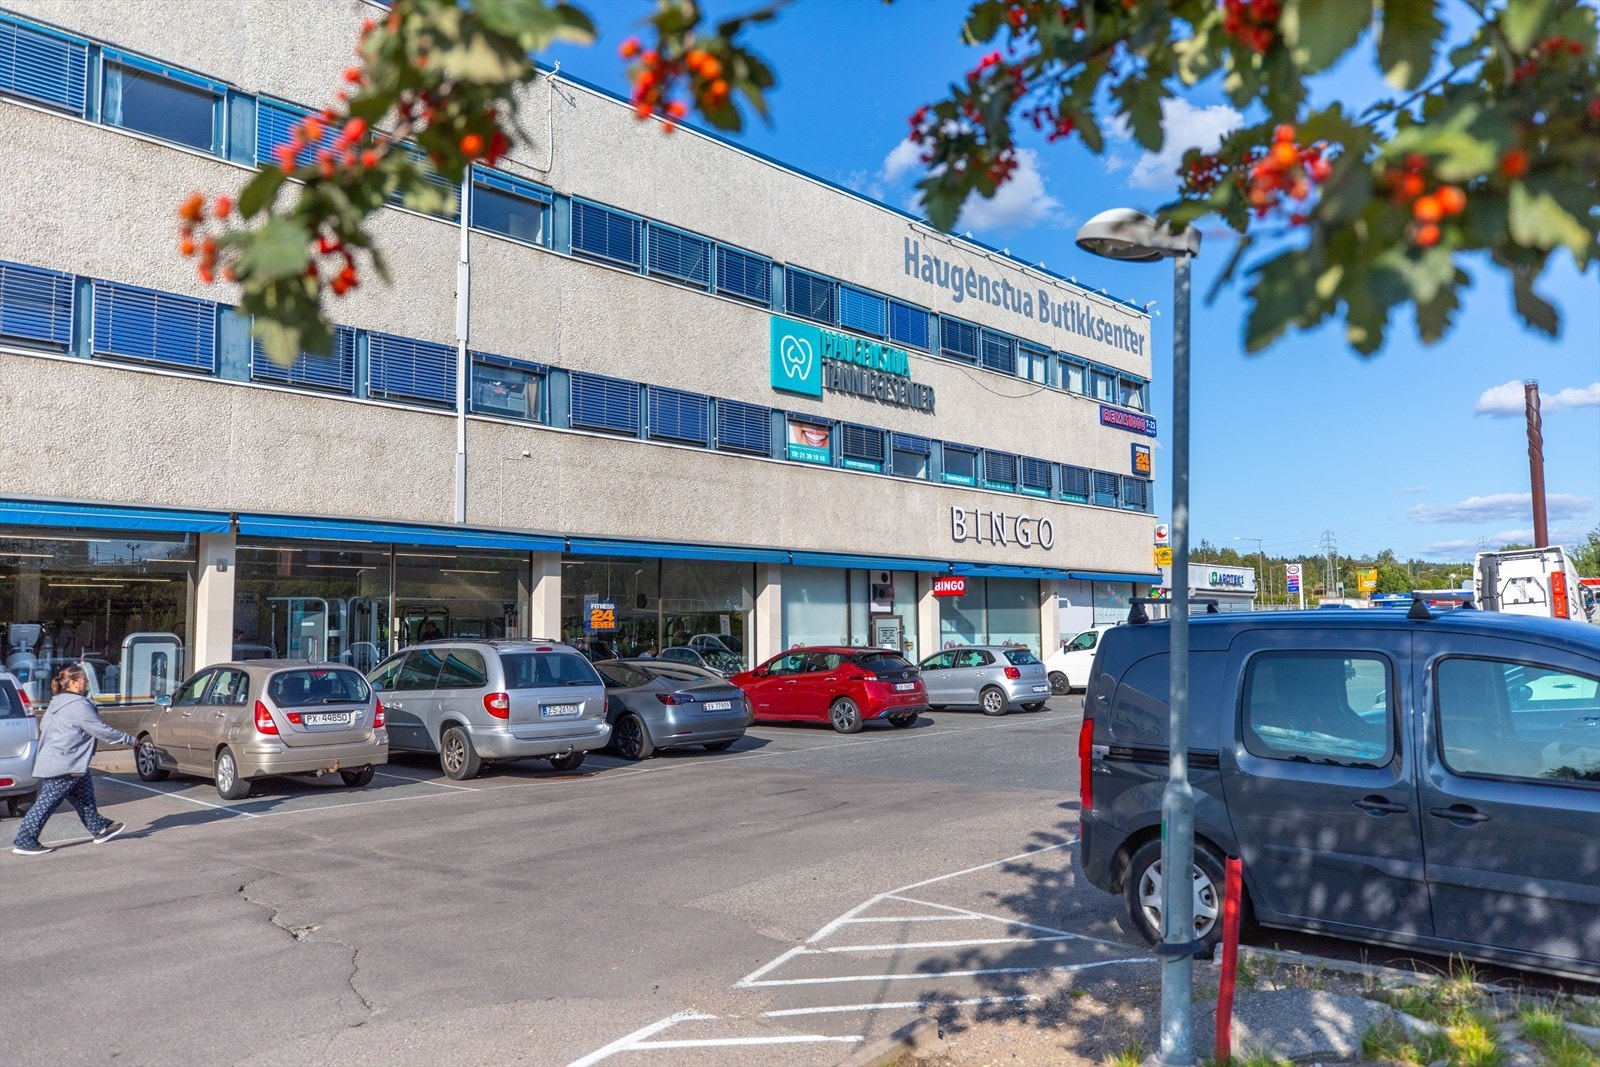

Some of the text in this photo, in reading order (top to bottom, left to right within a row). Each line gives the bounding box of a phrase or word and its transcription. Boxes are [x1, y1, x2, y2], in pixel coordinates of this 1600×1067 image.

[903, 236, 1145, 357] Haugenstua Butikksenter
[1135, 451, 1150, 465] 24
[951, 506, 1054, 550] BINGO
[1218, 573, 1241, 585] APOTEK
[934, 580, 965, 591] BINGO
[591, 609, 615, 622] 24
[591, 621, 615, 629] SEVEN
[306, 715, 317, 723] PX
